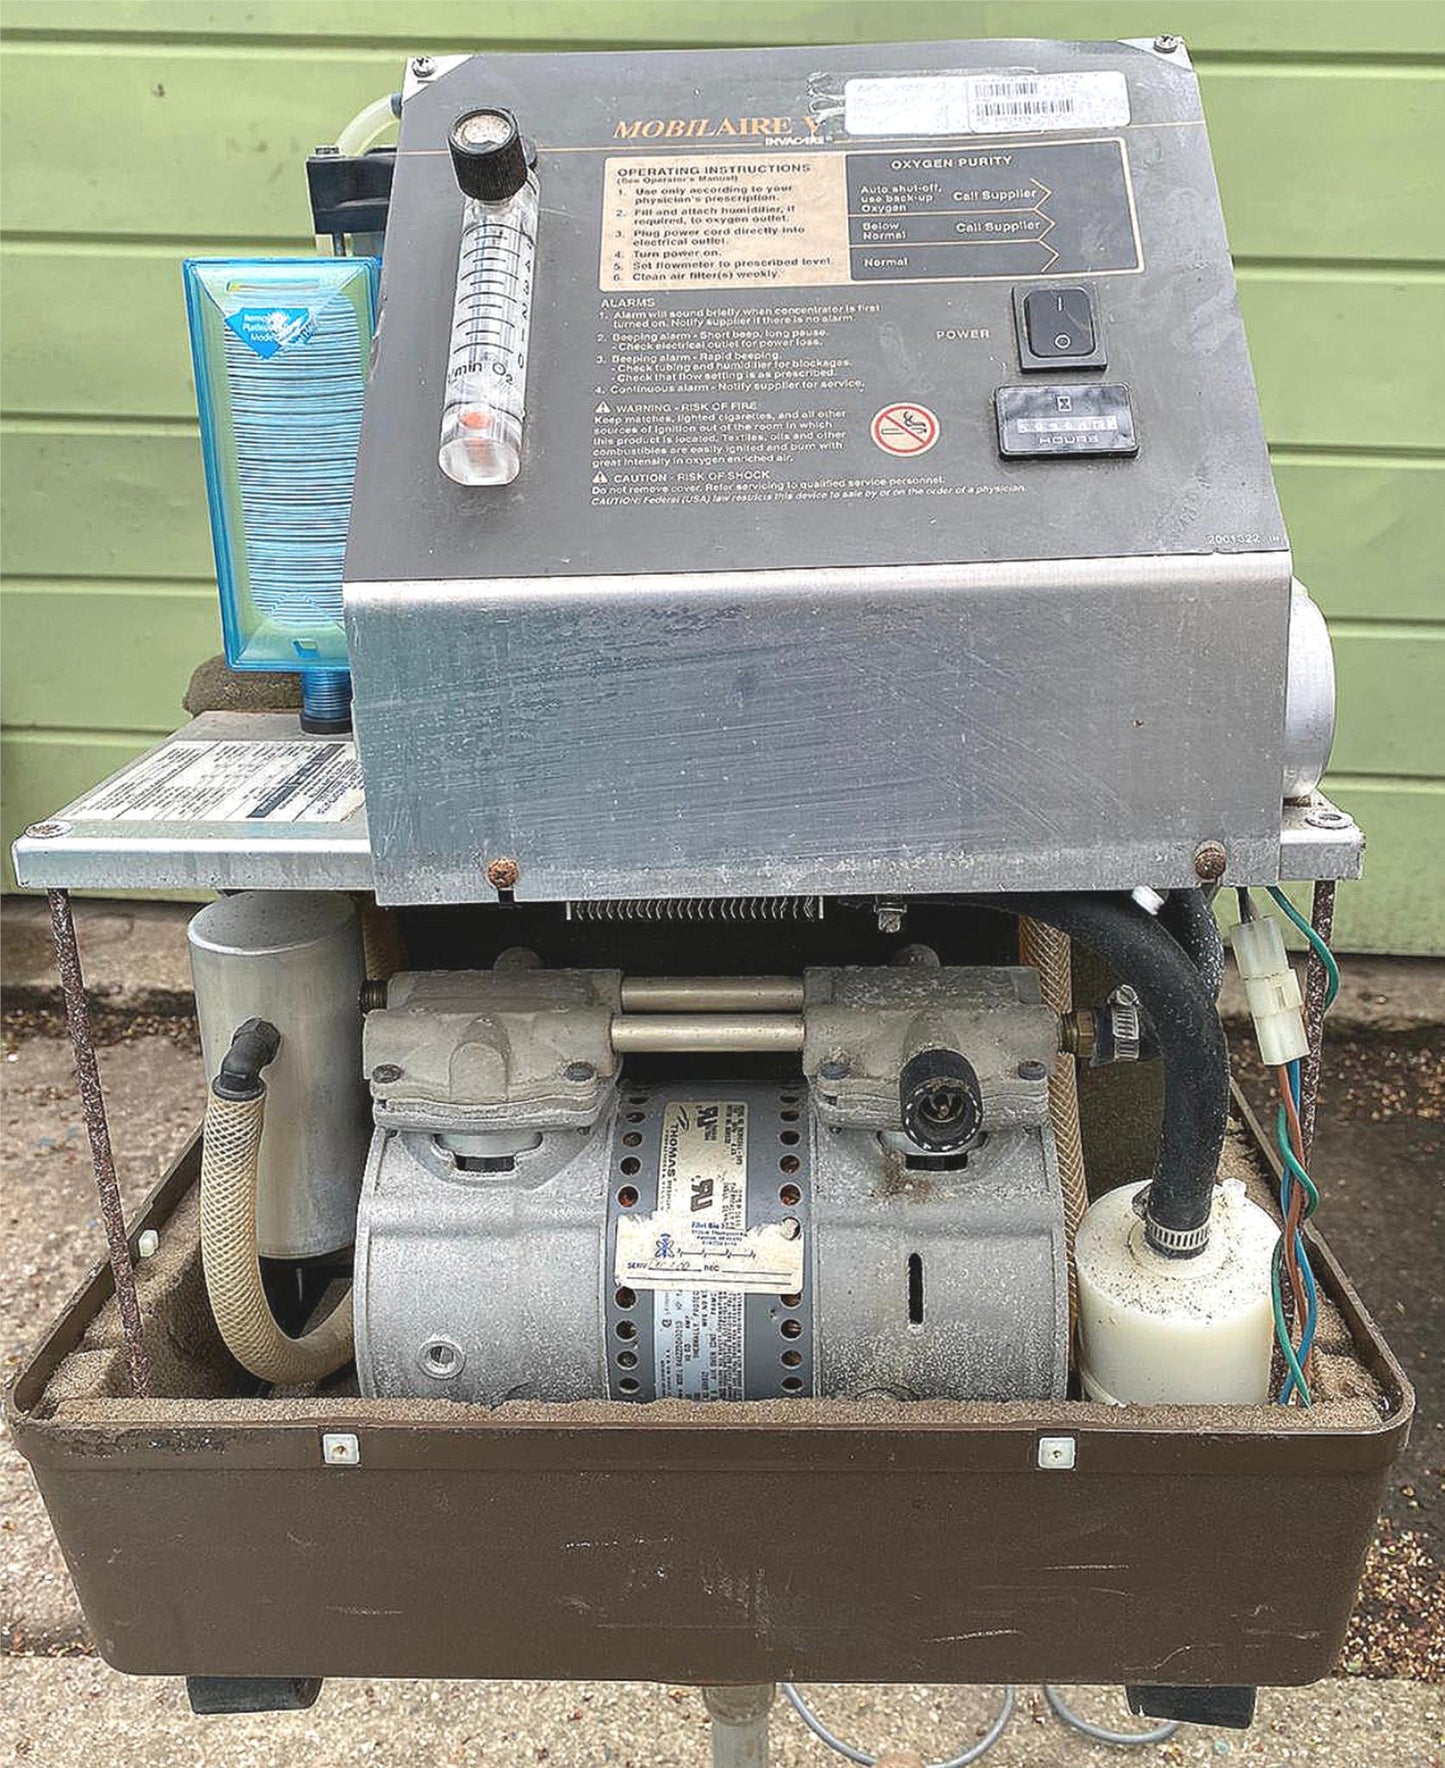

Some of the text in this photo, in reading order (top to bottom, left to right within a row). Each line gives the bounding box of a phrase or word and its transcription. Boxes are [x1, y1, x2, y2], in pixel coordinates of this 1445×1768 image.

[612, 116, 792, 139] MOBILAIRE
[891, 156, 1013, 170] OXYGEN PURITY
[617, 164, 811, 177] OPERATING INSTRUCTIONS
[661, 187, 686, 196] only
[689, 185, 748, 195] according
[766, 185, 792, 194] your
[860, 185, 888, 194] Auto
[953, 188, 1038, 202] Call Supplier
[635, 195, 701, 205] physician's
[634, 205, 784, 216] Fill and attach humidifier,
[861, 204, 907, 213] Oxygen
[634, 216, 687, 226] required,
[705, 215, 749, 224] oxygen
[862, 222, 900, 231] Below
[956, 220, 1041, 233] Call Supplier
[633, 229, 660, 238] Plug
[664, 229, 699, 238] power
[703, 228, 730, 236] cord
[734, 226, 778, 235] directly
[863, 231, 906, 240] Normal
[633, 238, 688, 246] electrical
[633, 248, 722, 259] Turn power on.
[633, 261, 652, 270] Set
[656, 260, 714, 269] flowmeter
[734, 259, 798, 268] prescribed
[864, 257, 908, 267] Normal
[633, 271, 733, 281] Clean air filter(s)
[601, 298, 656, 308] ALARMS
[522, 303, 528, 319] 2
[613, 311, 646, 319] Alarm
[649, 310, 667, 318] will
[669, 308, 704, 318] sound
[742, 307, 772, 316] when
[774, 304, 843, 315] concentrator
[858, 303, 881, 312] first
[613, 319, 649, 329] turned
[671, 318, 704, 328] Notify
[706, 316, 751, 327] supplier
[612, 333, 658, 343] Beeping
[660, 331, 691, 341] alarm
[700, 330, 730, 340] Short
[765, 329, 789, 339] long
[936, 330, 990, 340] POWER
[618, 338, 793, 351] Check electrical outlet for power
[518, 353, 525, 369] 0
[612, 354, 657, 365] Beeping
[660, 353, 691, 362] alarm
[700, 352, 732, 362] Rapid
[617, 363, 653, 373] Check
[655, 362, 690, 373] tubing
[693, 362, 714, 371] and
[716, 360, 771, 370] humidifier
[617, 373, 652, 382] Check
[655, 372, 676, 381] that
[679, 371, 702, 380] flow
[705, 370, 744, 381] setting
[610, 380, 800, 394] Continuous alarm Notify supplier
[616, 401, 757, 413] WARNING RISK OF FIRE
[594, 416, 622, 426] Keep
[678, 413, 716, 424] lighted
[778, 410, 799, 420] and
[817, 409, 846, 418] other
[594, 420, 833, 436] sources ignition out room which
[593, 437, 614, 446] this
[617, 436, 660, 447] product
[770, 431, 790, 440] oils
[793, 431, 814, 440] and
[816, 429, 846, 439] other
[1039, 434, 1099, 444] HOURS
[592, 446, 667, 457] combustibles
[670, 446, 688, 455] are
[766, 442, 788, 452] and
[819, 440, 844, 450] with
[592, 453, 774, 468] great intensity oxygen enriched
[614, 470, 770, 484] CAUTION RISK OF SHOCK
[609, 484, 627, 494] not
[629, 484, 669, 494] remove
[735, 481, 784, 492] servicing
[848, 477, 886, 487] service
[795, 489, 827, 500] device
[667, 1123, 680, 1178] THOMAS
